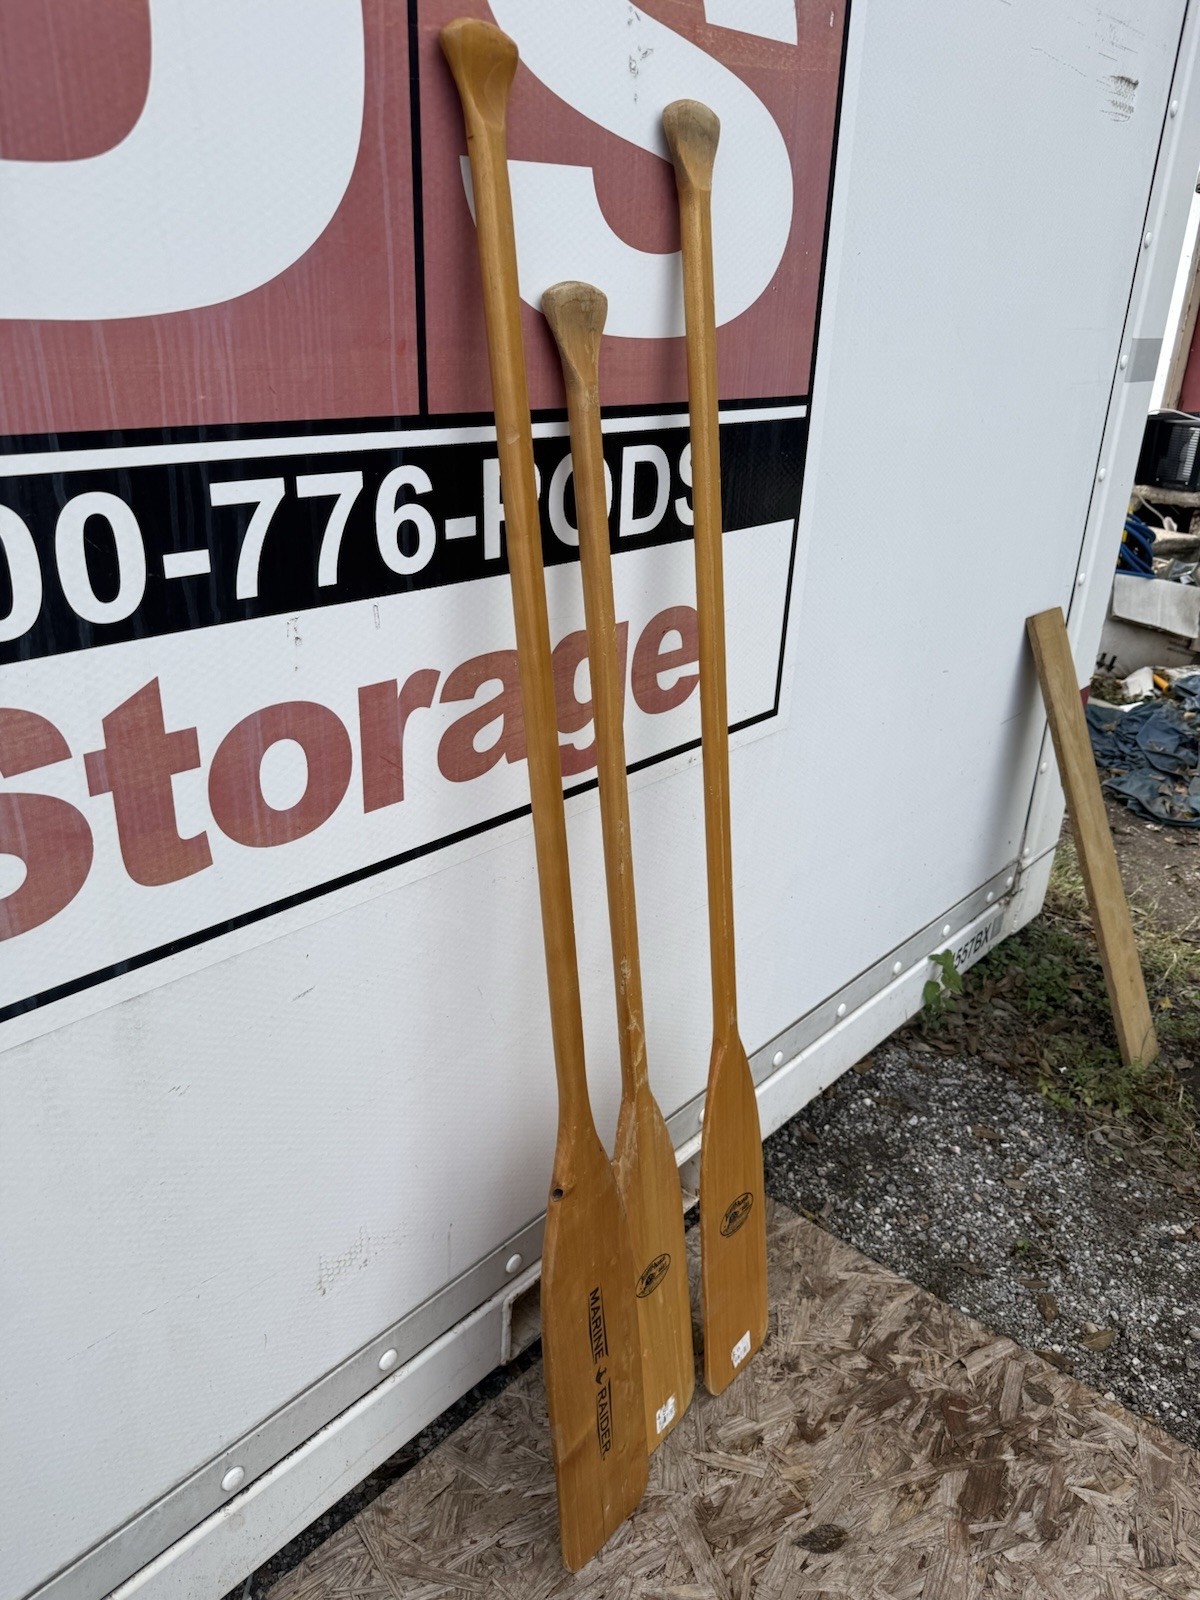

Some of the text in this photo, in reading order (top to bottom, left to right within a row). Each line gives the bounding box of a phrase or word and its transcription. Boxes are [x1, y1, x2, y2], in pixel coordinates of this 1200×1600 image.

[953, 923, 992, 969] 557BX
[589, 1286, 612, 1456] MARINE RAIDER
